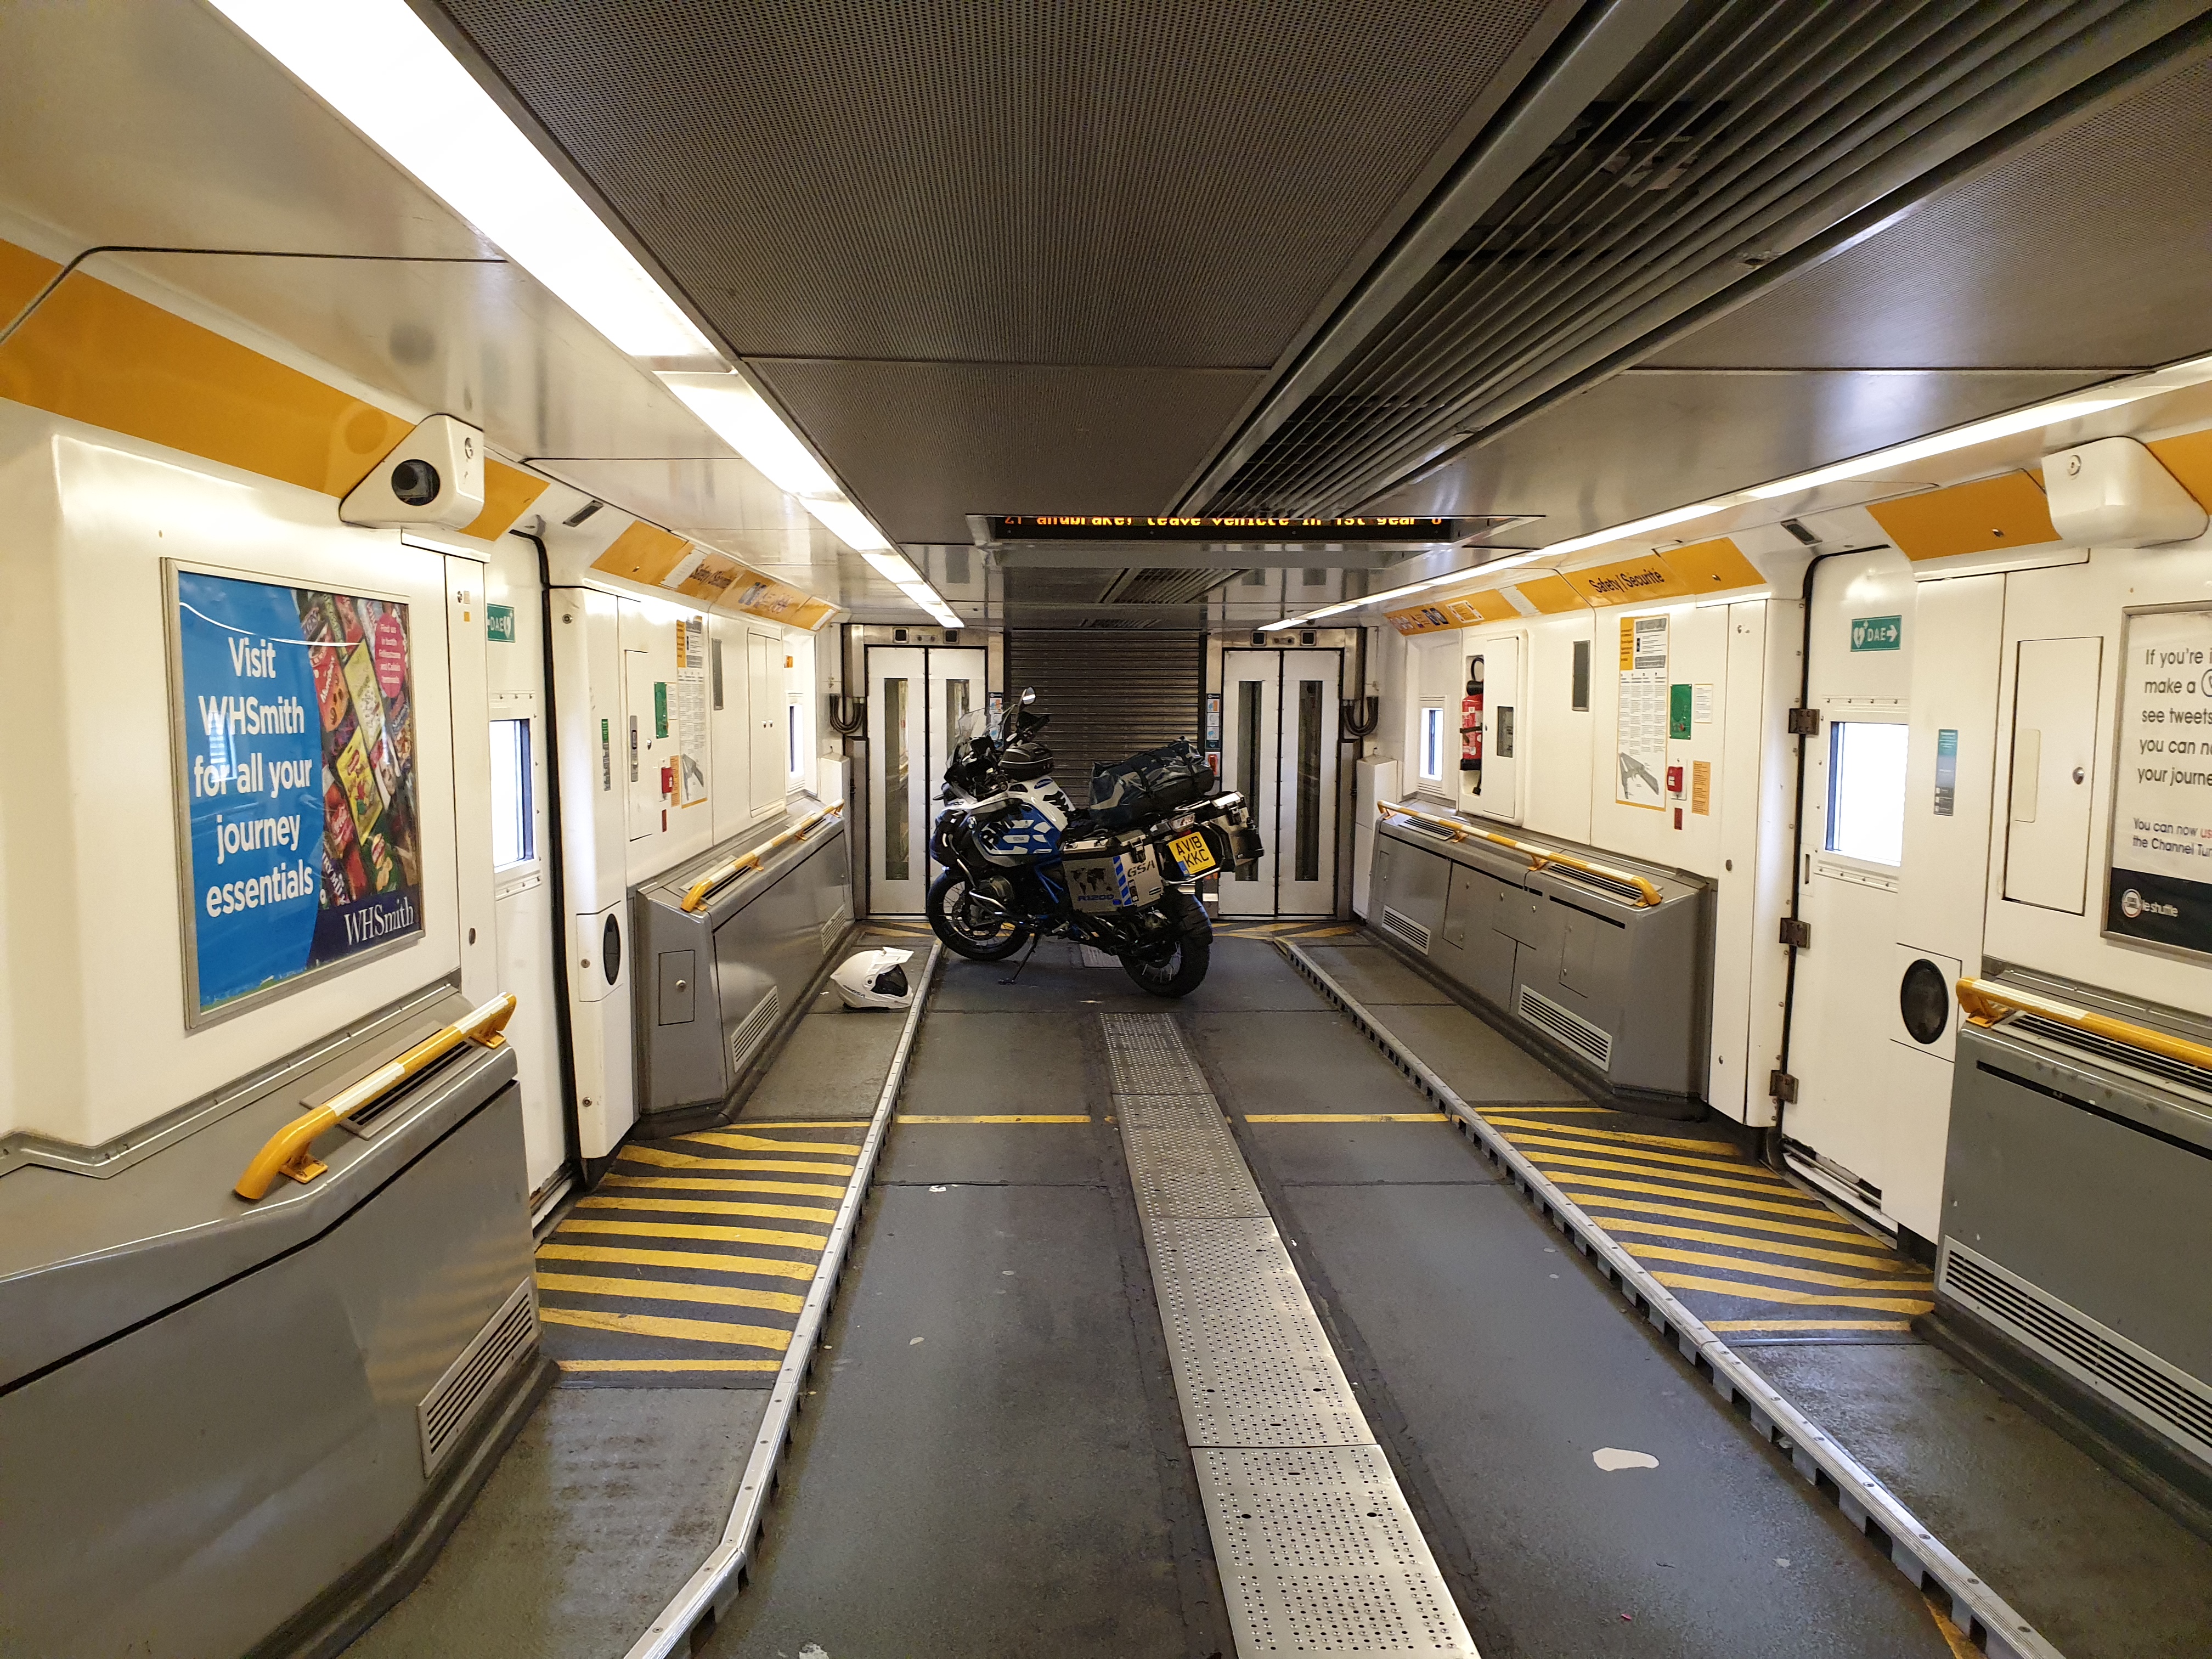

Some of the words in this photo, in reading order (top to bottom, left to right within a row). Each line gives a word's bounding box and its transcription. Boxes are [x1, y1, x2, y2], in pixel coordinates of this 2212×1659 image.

[1588, 577, 1625, 593] Safety
[1867, 627, 1887, 642] DAE
[228, 637, 276, 678] Visit
[2145, 648, 2155, 665] If
[2160, 648, 2203, 668] you're
[2144, 678, 2182, 694] make
[2186, 681, 2196, 694] a
[198, 695, 304, 736] WHSmith
[2141, 710, 2165, 723] see
[2169, 707, 2212, 725] tweets
[2139, 739, 2164, 755] you
[2168, 741, 2196, 754] can
[194, 755, 230, 797] for
[236, 752, 263, 794] all
[268, 759, 312, 799] your
[2137, 768, 2168, 784] your
[2133, 817, 2151, 831] You
[2153, 822, 2174, 834] can
[2176, 826, 2198, 837] now
[216, 814, 301, 865] journey
[1175, 836, 1203, 856] AV18
[2132, 834, 2148, 848] the
[2151, 838, 2194, 855] Channel
[1127, 860, 1155, 877] GSA
[1183, 849, 1209, 868] KKC
[206, 859, 314, 917] essentials
[343, 896, 415, 946] WHSmith
